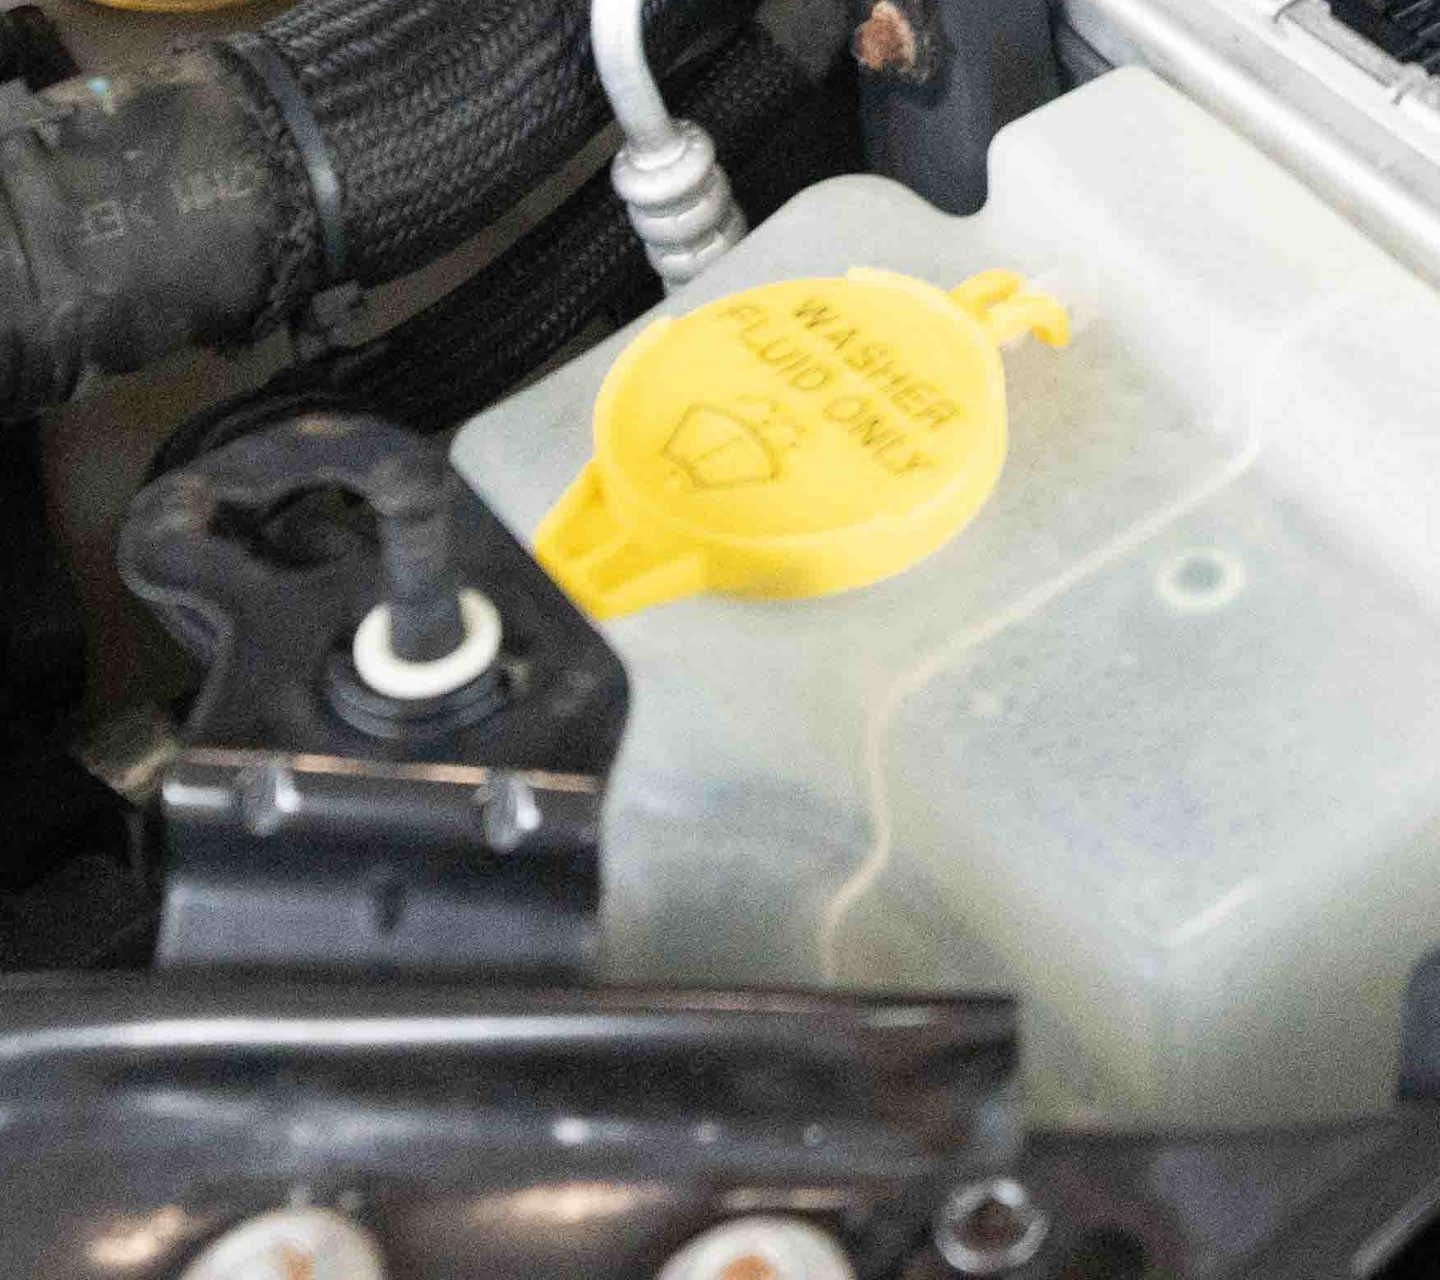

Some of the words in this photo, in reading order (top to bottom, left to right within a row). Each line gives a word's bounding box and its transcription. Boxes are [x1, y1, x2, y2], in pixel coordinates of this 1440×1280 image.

[722, 300, 832, 393] FLUID
[823, 394, 934, 478] ONLY
[792, 295, 962, 432] WASHER
